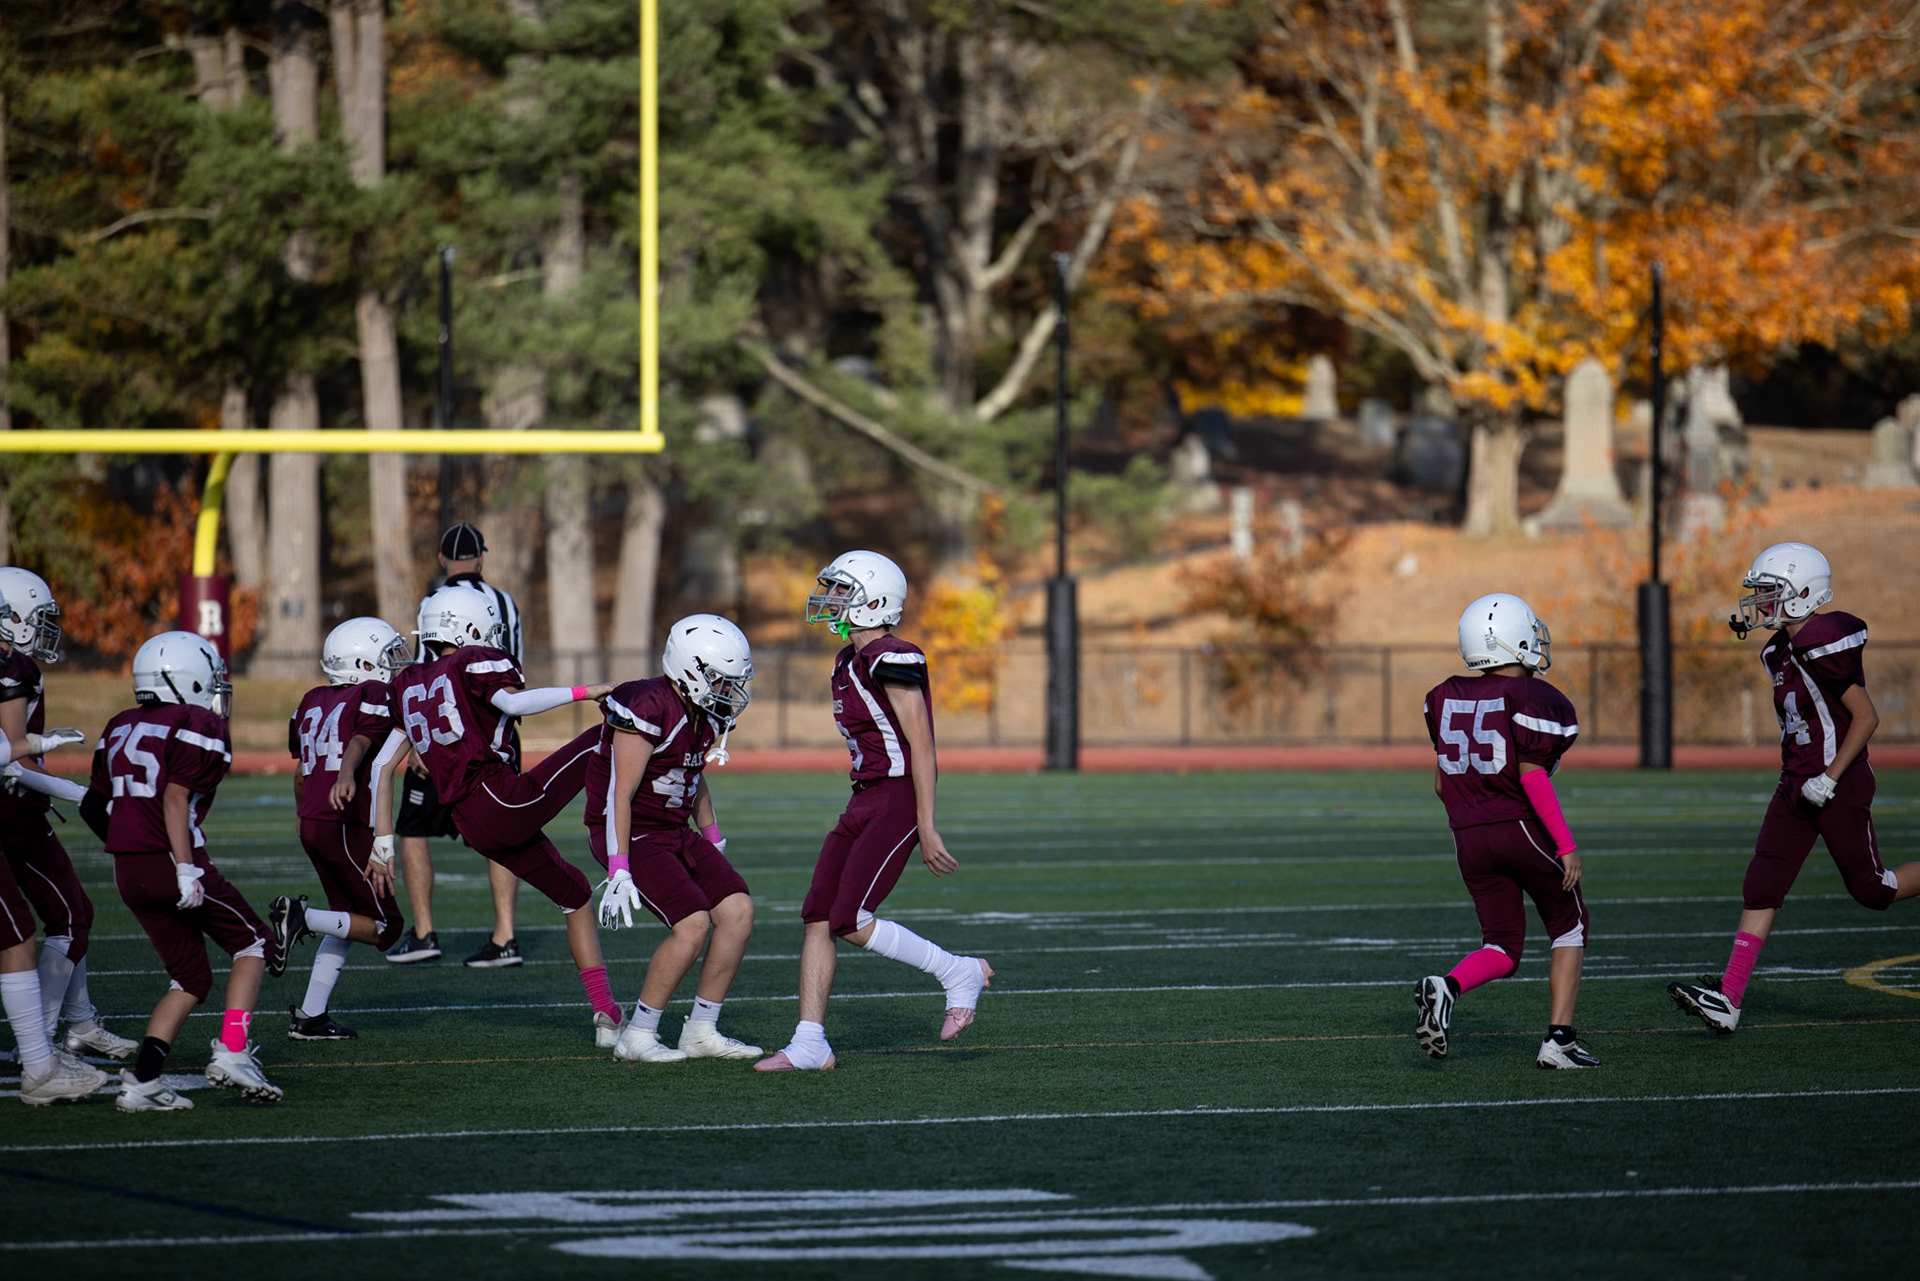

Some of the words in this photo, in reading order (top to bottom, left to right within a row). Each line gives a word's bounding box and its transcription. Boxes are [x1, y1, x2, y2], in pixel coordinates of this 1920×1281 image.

[198, 599, 223, 646] R
[298, 702, 344, 776] 84
[402, 674, 465, 755] 63
[1437, 697, 1507, 775] 55
[1777, 691, 1811, 745] 4
